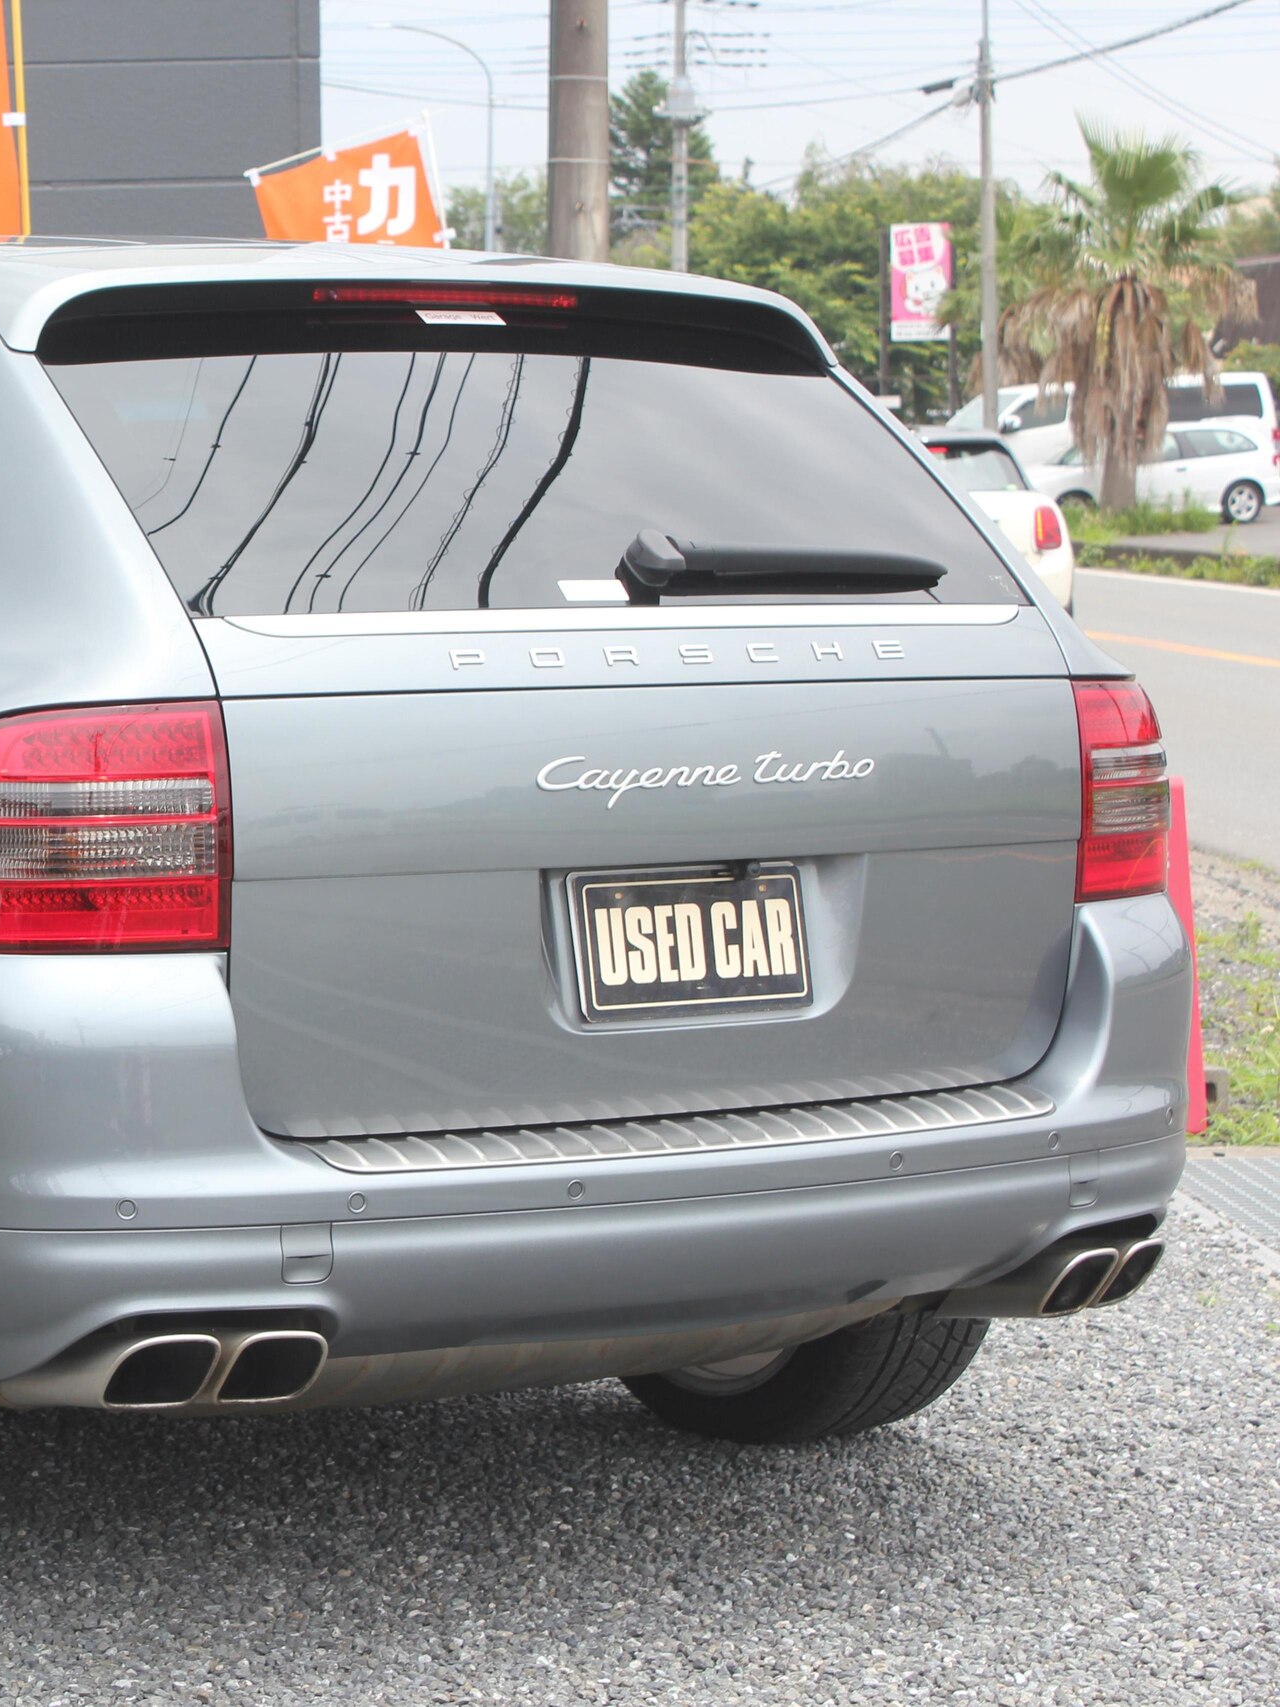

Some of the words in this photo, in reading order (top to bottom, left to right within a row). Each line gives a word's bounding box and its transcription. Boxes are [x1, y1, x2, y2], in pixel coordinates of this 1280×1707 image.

[322, 178, 353, 243] 中古
[356, 153, 417, 244] カ
[448, 639, 906, 671] PORSCHE
[535, 755, 743, 810] Cayenne
[752, 749, 876, 784] turbo
[593, 902, 709, 987] USED
[709, 898, 798, 980] CAR
